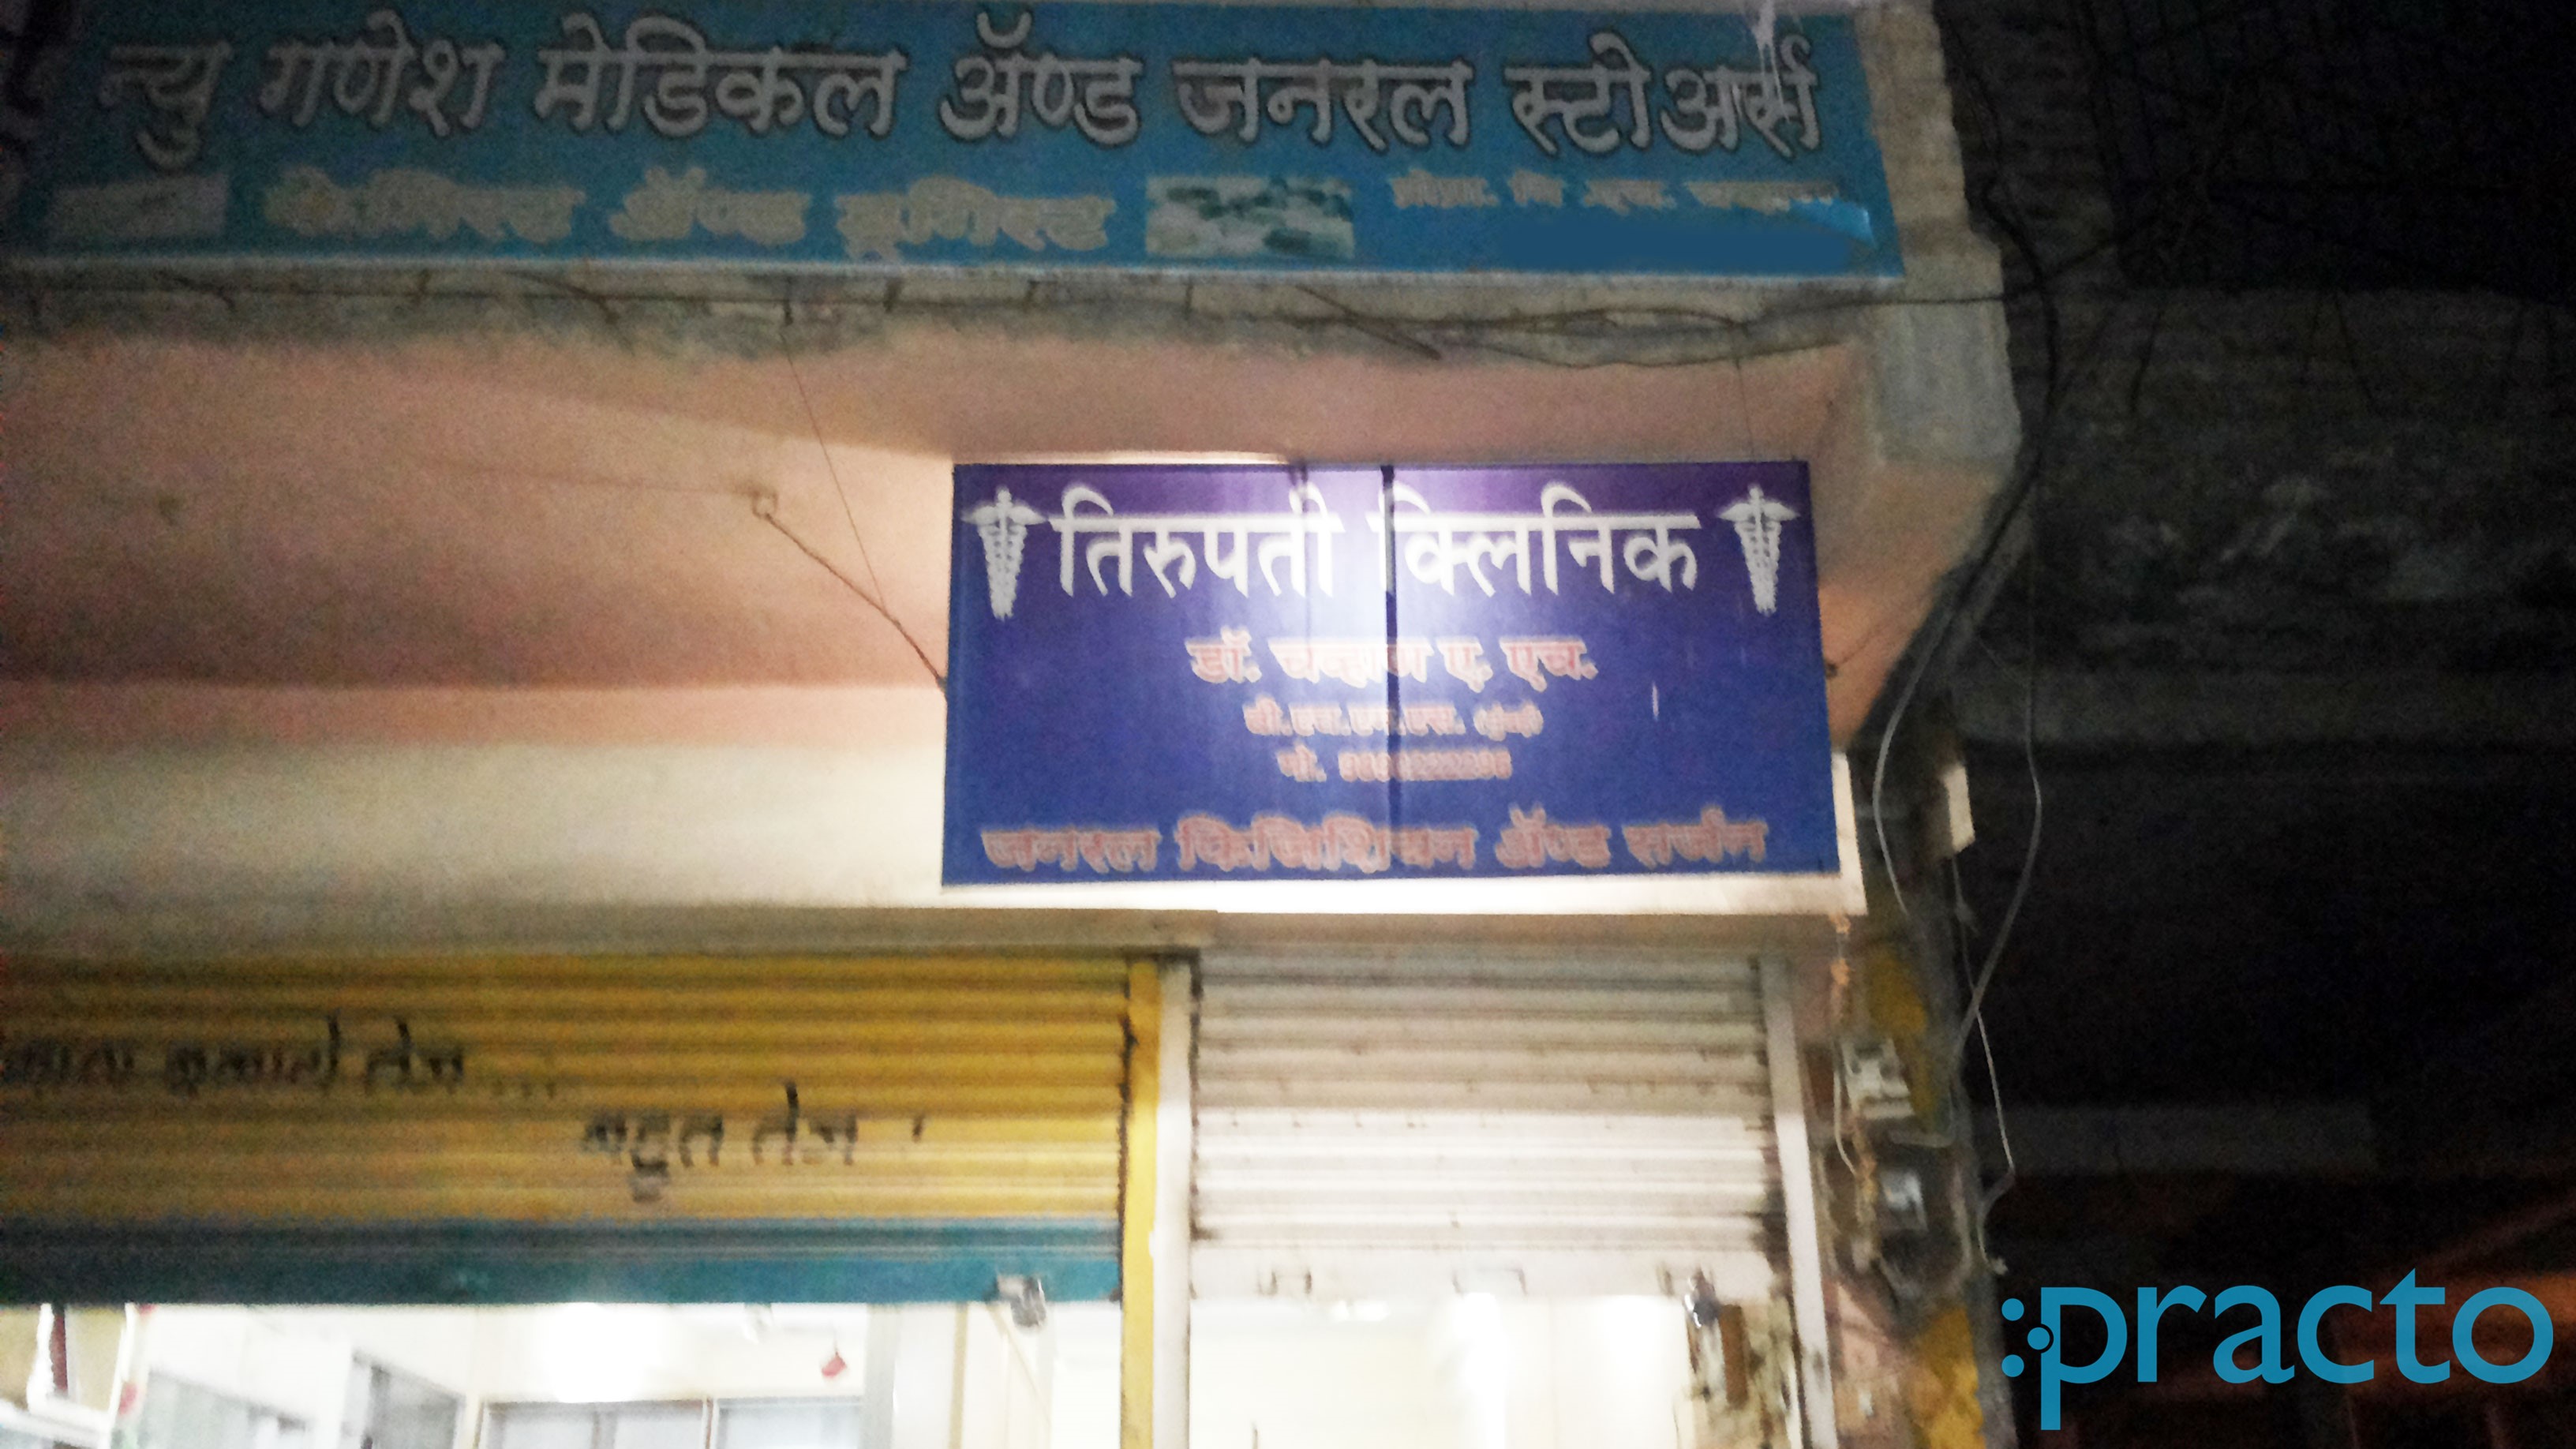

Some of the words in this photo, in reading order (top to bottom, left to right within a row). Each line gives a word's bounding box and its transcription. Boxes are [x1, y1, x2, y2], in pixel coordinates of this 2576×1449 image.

[259, 9, 505, 137] गणेश
[534, 11, 909, 135] मेडिकल
[1172, 55, 1473, 150] जनरल
[1050, 482, 1345, 597] तिरुपती
[1365, 481, 1702, 597] क्लिनिक
[1185, 627, 1262, 683] डॉ.
[981, 825, 1162, 874] जनरल
[1622, 803, 1768, 868] सर्जन
